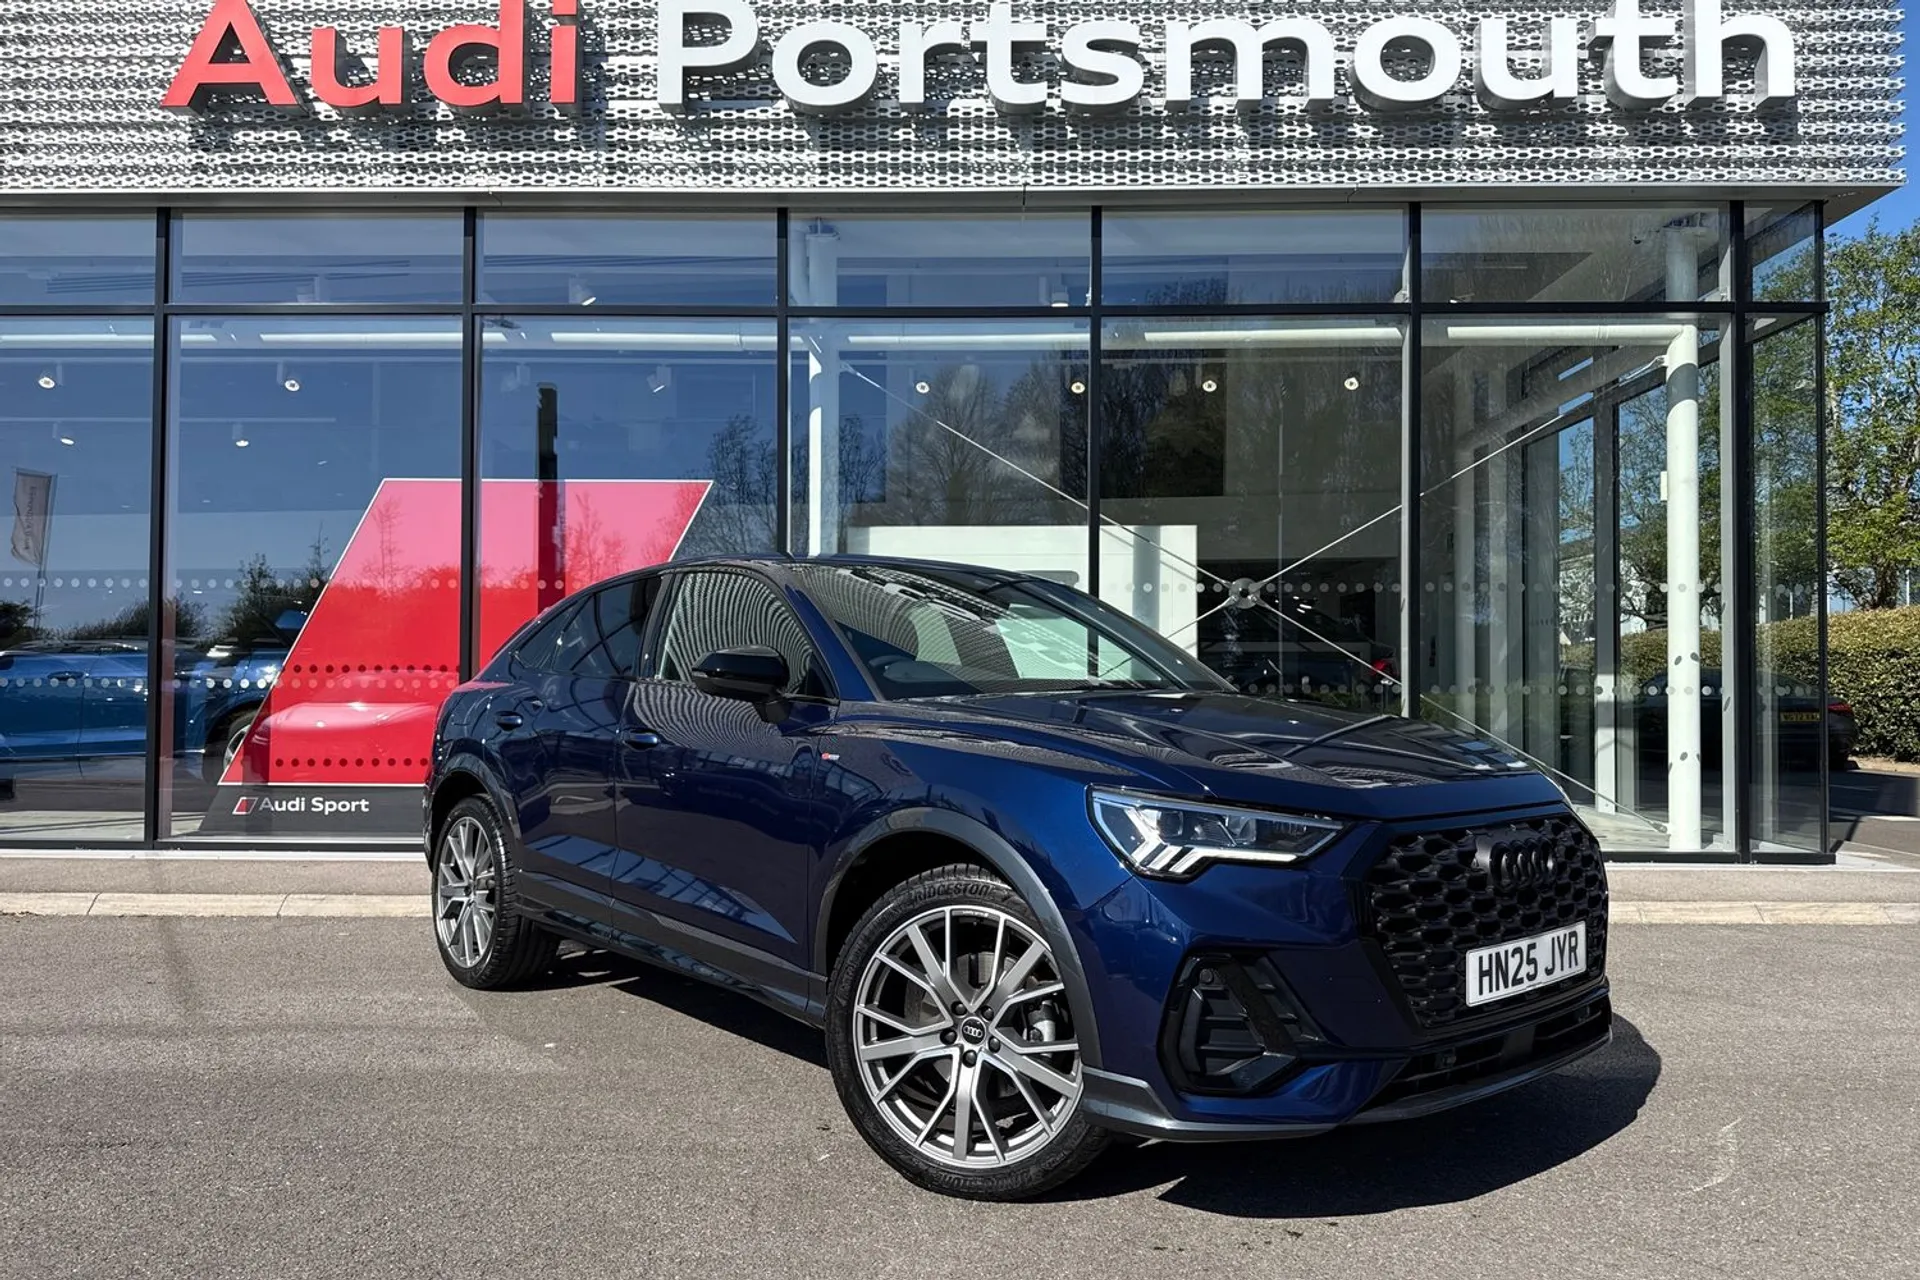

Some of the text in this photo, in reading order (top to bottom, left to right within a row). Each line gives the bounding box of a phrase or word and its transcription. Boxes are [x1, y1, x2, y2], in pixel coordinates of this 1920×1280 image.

[160, 0, 1797, 108] Audi Portsmouth
[259, 797, 370, 815] Audi Sport
[1478, 930, 1579, 996] HN25 JYR
